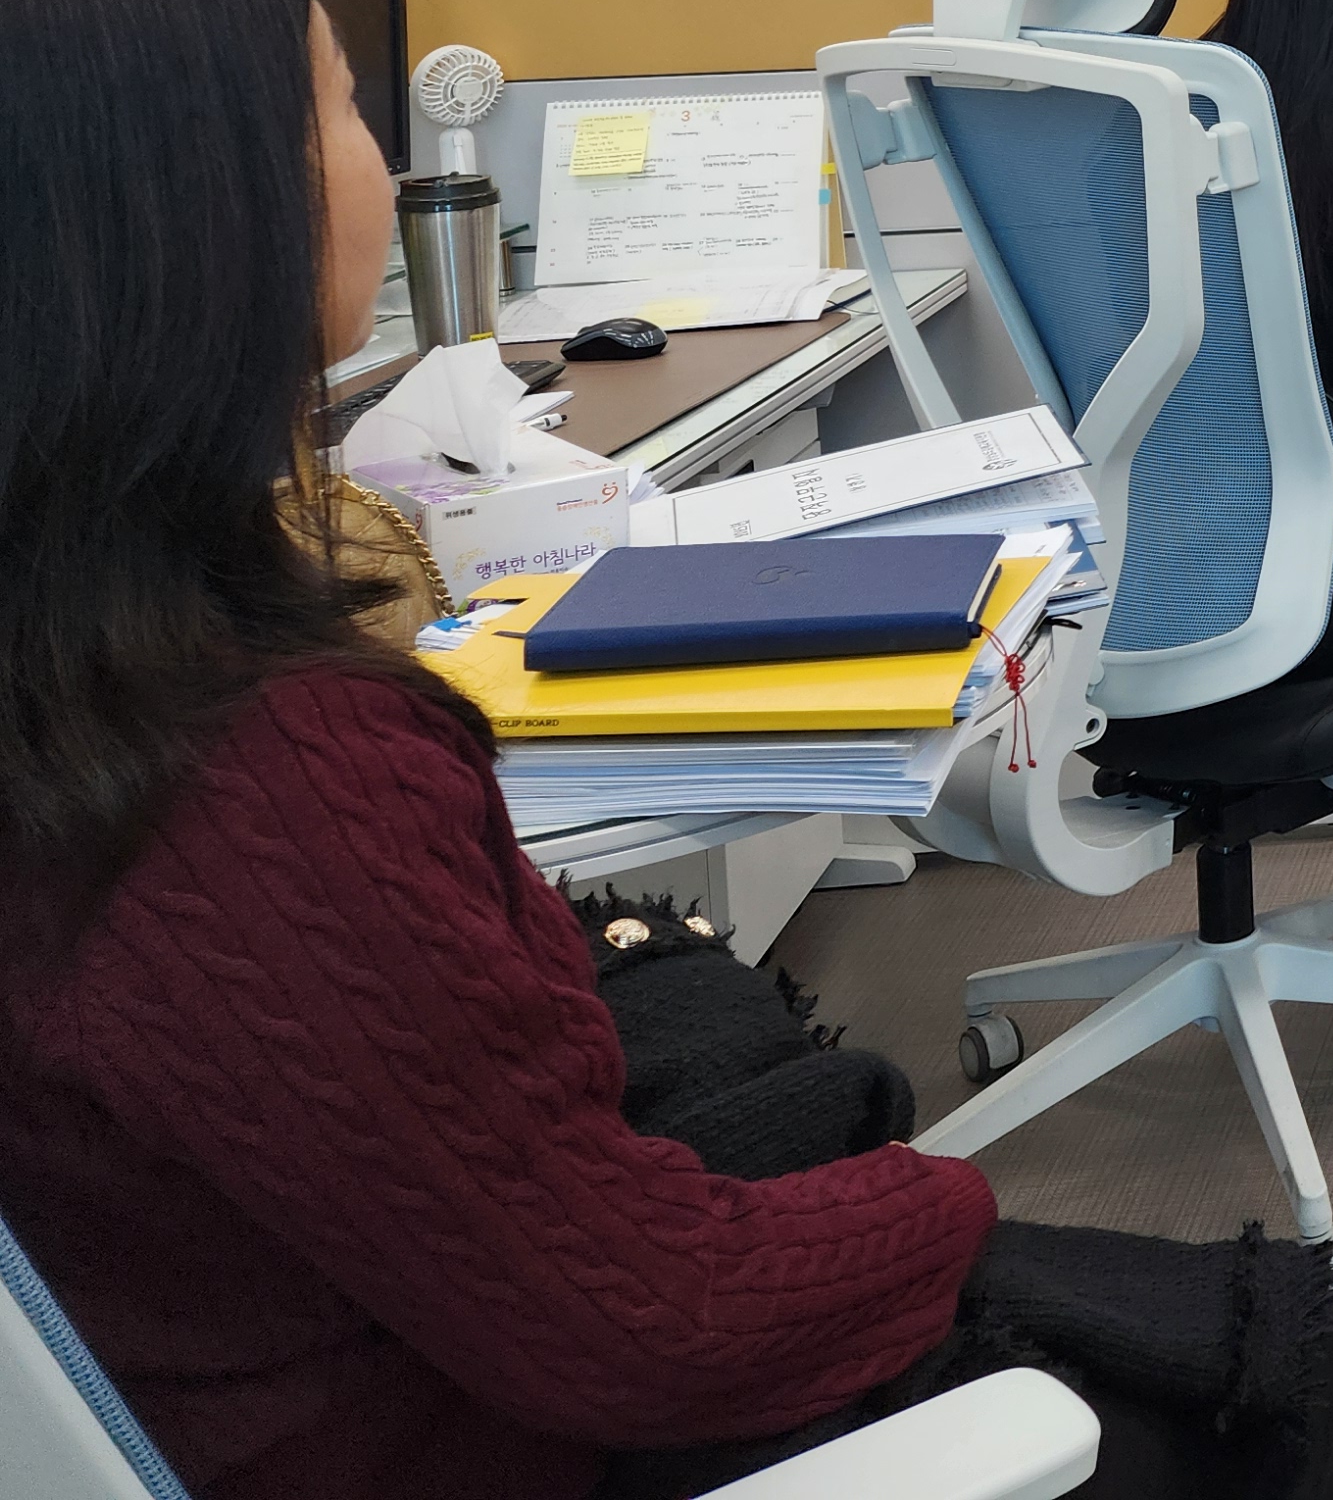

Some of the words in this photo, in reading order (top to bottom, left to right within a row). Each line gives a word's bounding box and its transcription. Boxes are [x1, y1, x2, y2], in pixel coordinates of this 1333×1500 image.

[681, 110, 690, 122] 3
[475, 556, 527, 581] 행복한
[533, 541, 597, 568] 아침나라
[525, 719, 559, 727] BOARD
